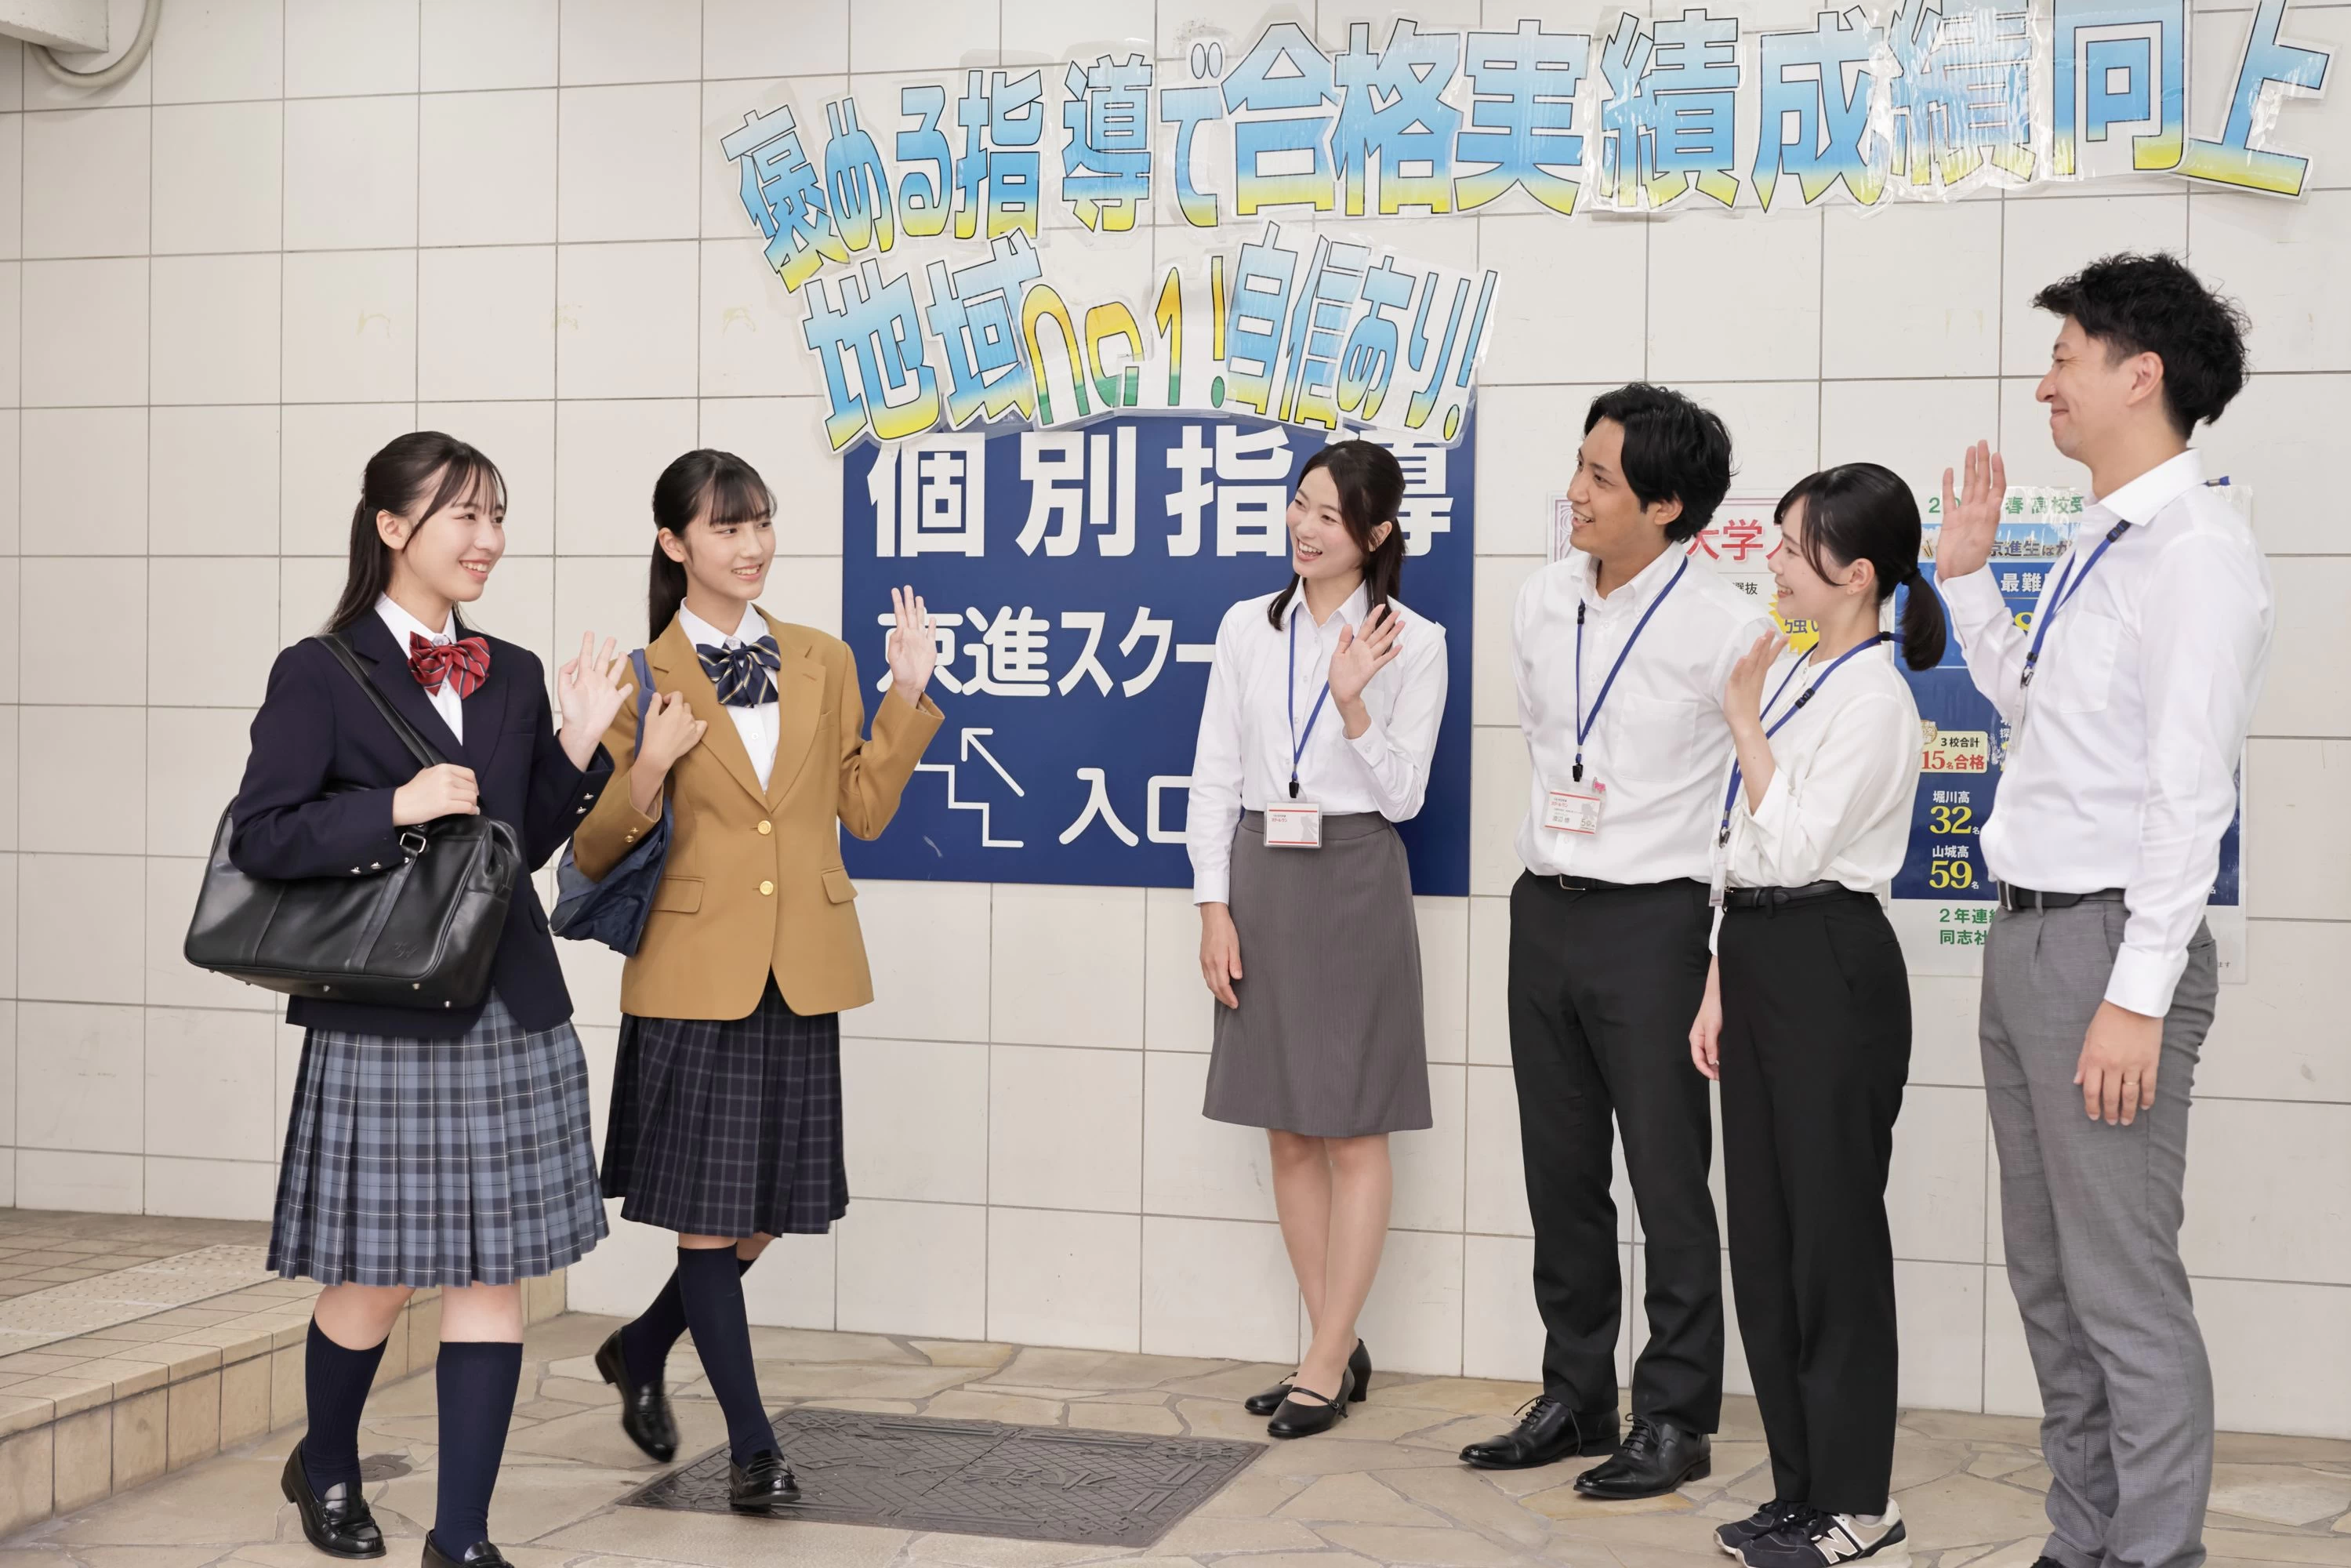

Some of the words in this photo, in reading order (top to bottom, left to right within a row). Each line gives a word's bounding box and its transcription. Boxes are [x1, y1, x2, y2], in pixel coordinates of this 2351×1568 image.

[2001, 572, 2048, 593] 最難
[1932, 790, 1970, 804] 堀川高
[1932, 845, 1969, 858] 山城高
